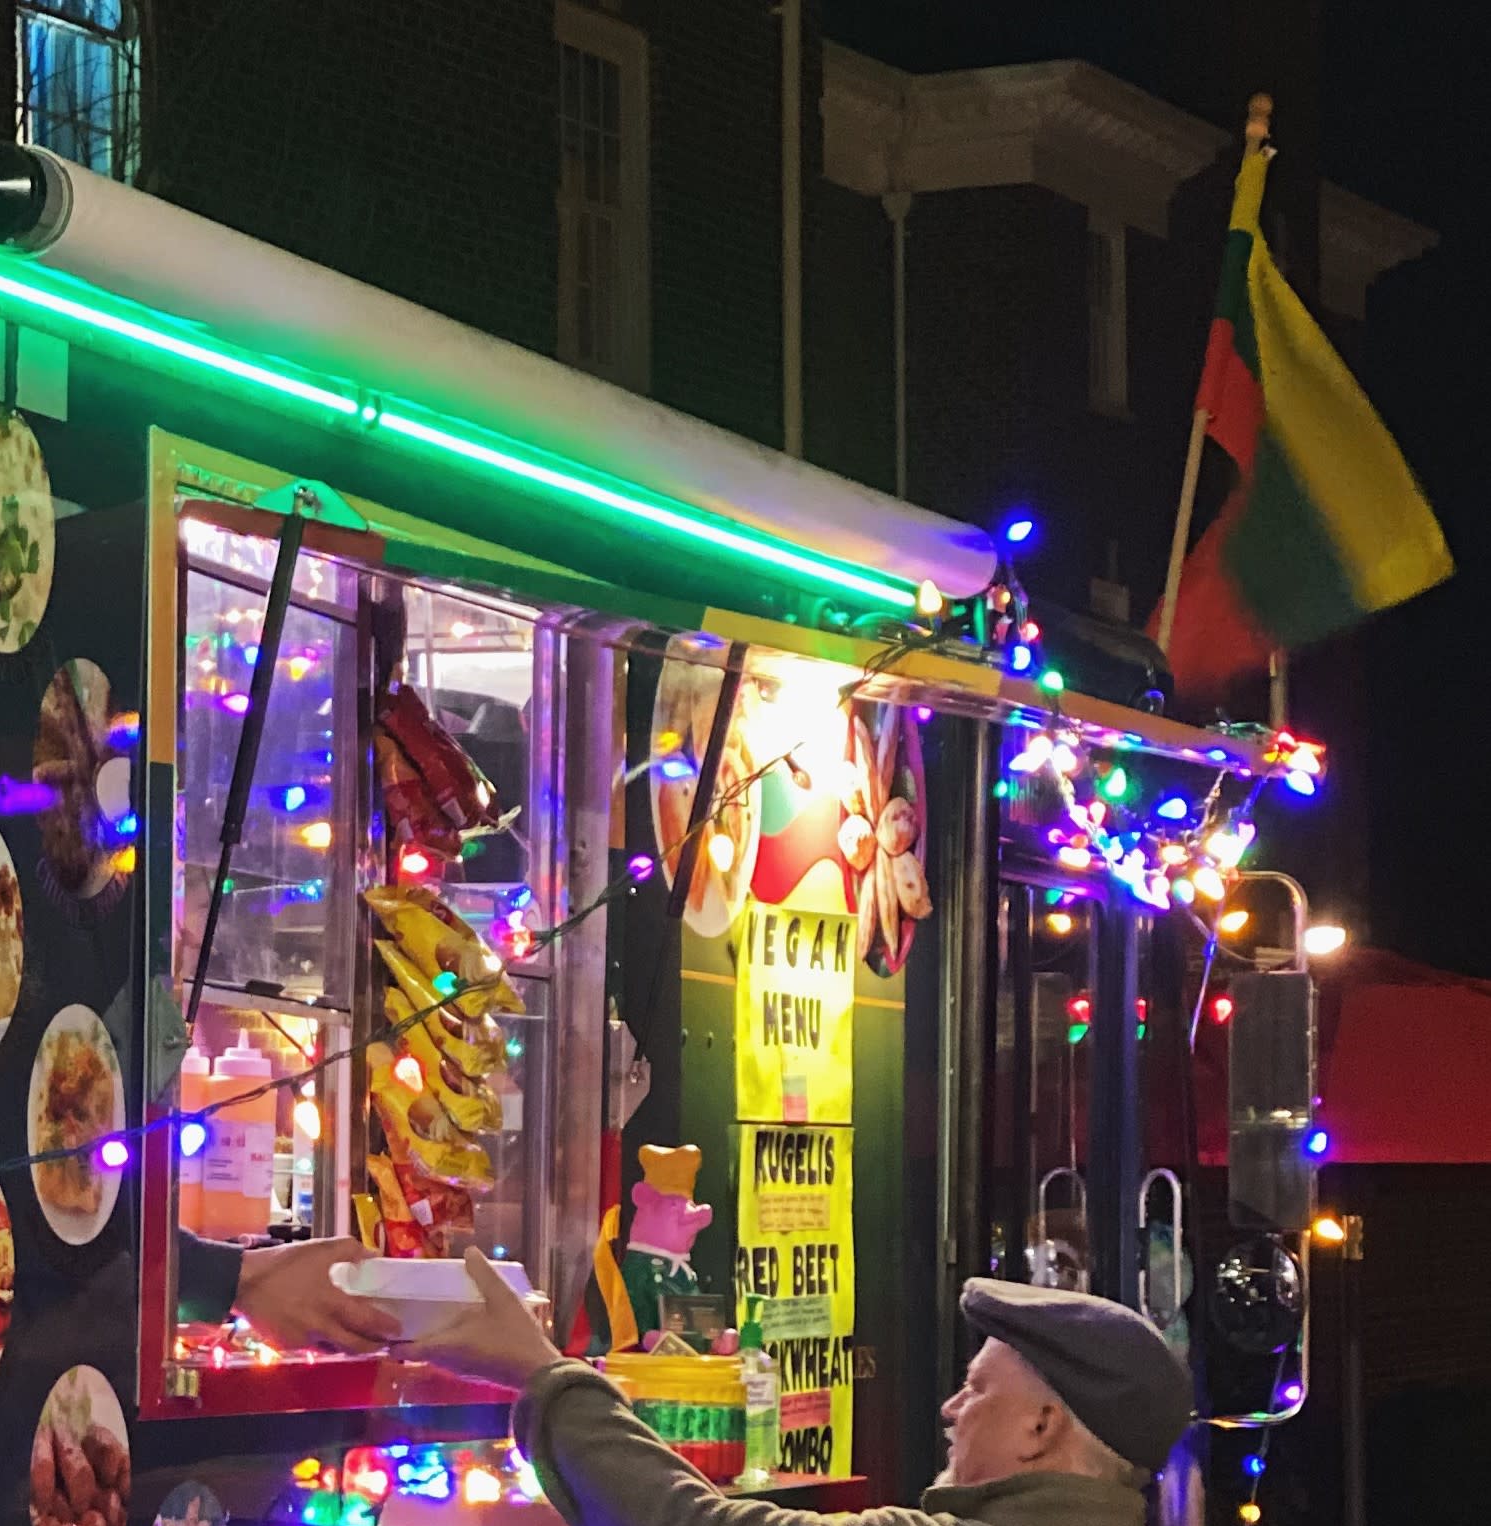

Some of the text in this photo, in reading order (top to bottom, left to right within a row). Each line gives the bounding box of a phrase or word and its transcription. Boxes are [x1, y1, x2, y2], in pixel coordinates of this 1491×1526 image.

[748, 911, 850, 972] VEGAN
[763, 990, 821, 1050] MENU
[753, 1130, 835, 1190] KUGELIS
[736, 1243, 839, 1300] RED BEET
